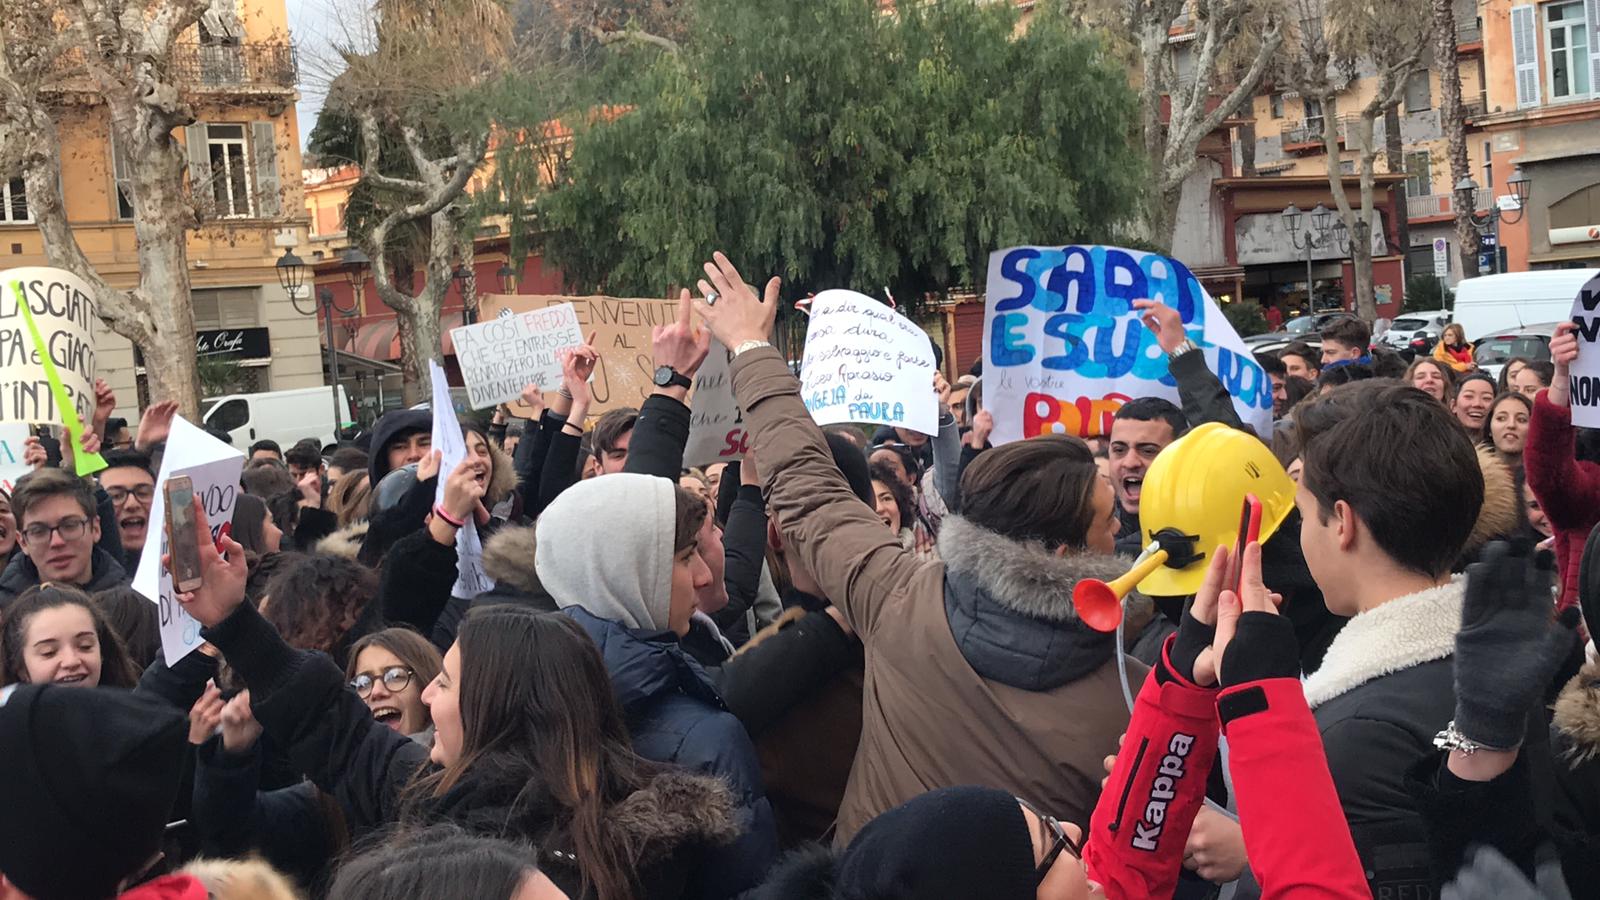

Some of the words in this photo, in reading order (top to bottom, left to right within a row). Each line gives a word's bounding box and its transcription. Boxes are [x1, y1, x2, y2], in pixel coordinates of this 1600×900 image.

[523, 307, 576, 333] FREDDO
[515, 327, 579, 356] ENTRASSE
[613, 332, 636, 349] AL
[848, 402, 904, 423] PAURA
[1132, 733, 1195, 851] Kappa
